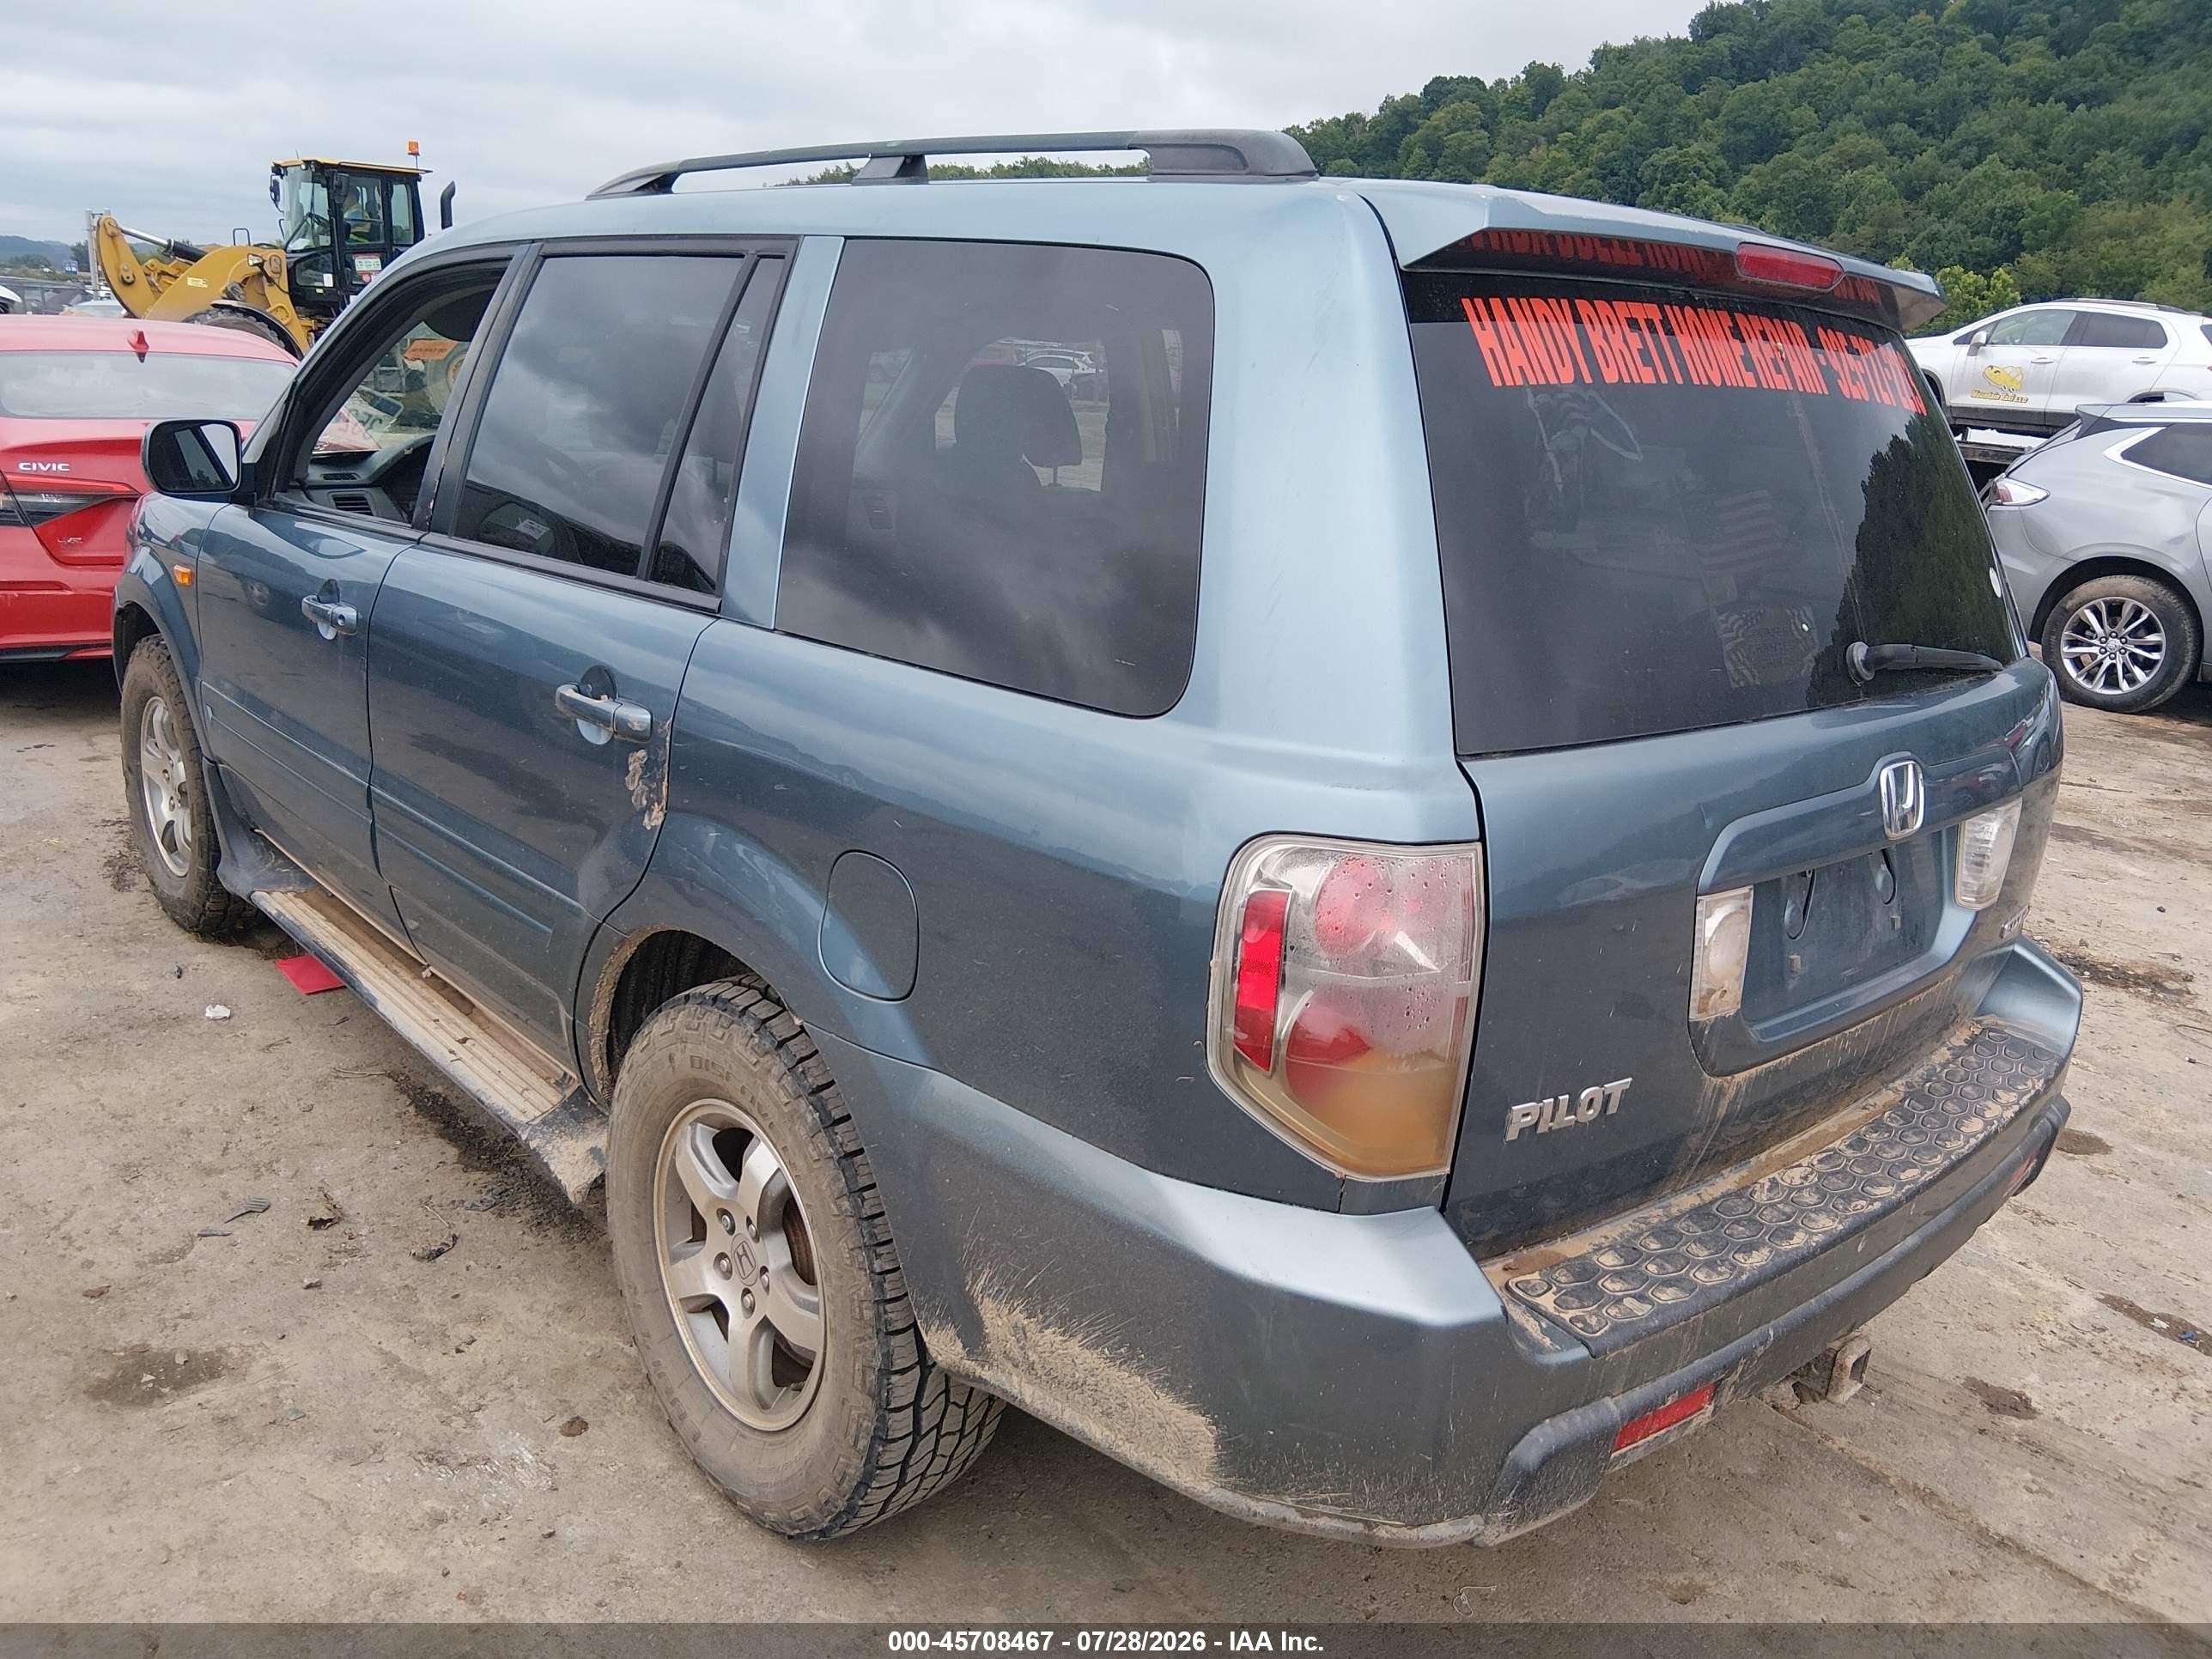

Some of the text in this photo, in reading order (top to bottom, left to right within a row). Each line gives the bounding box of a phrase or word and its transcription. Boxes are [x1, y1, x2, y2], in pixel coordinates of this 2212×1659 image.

[1462, 297, 1593, 387] HANDY
[1575, 299, 1683, 385] BRETT
[1663, 304, 1758, 388] HOME
[1734, 313, 1829, 395] REPAIR
[19, 462, 70, 471] CIVIC
[1505, 1077, 1632, 1142] PILOT
